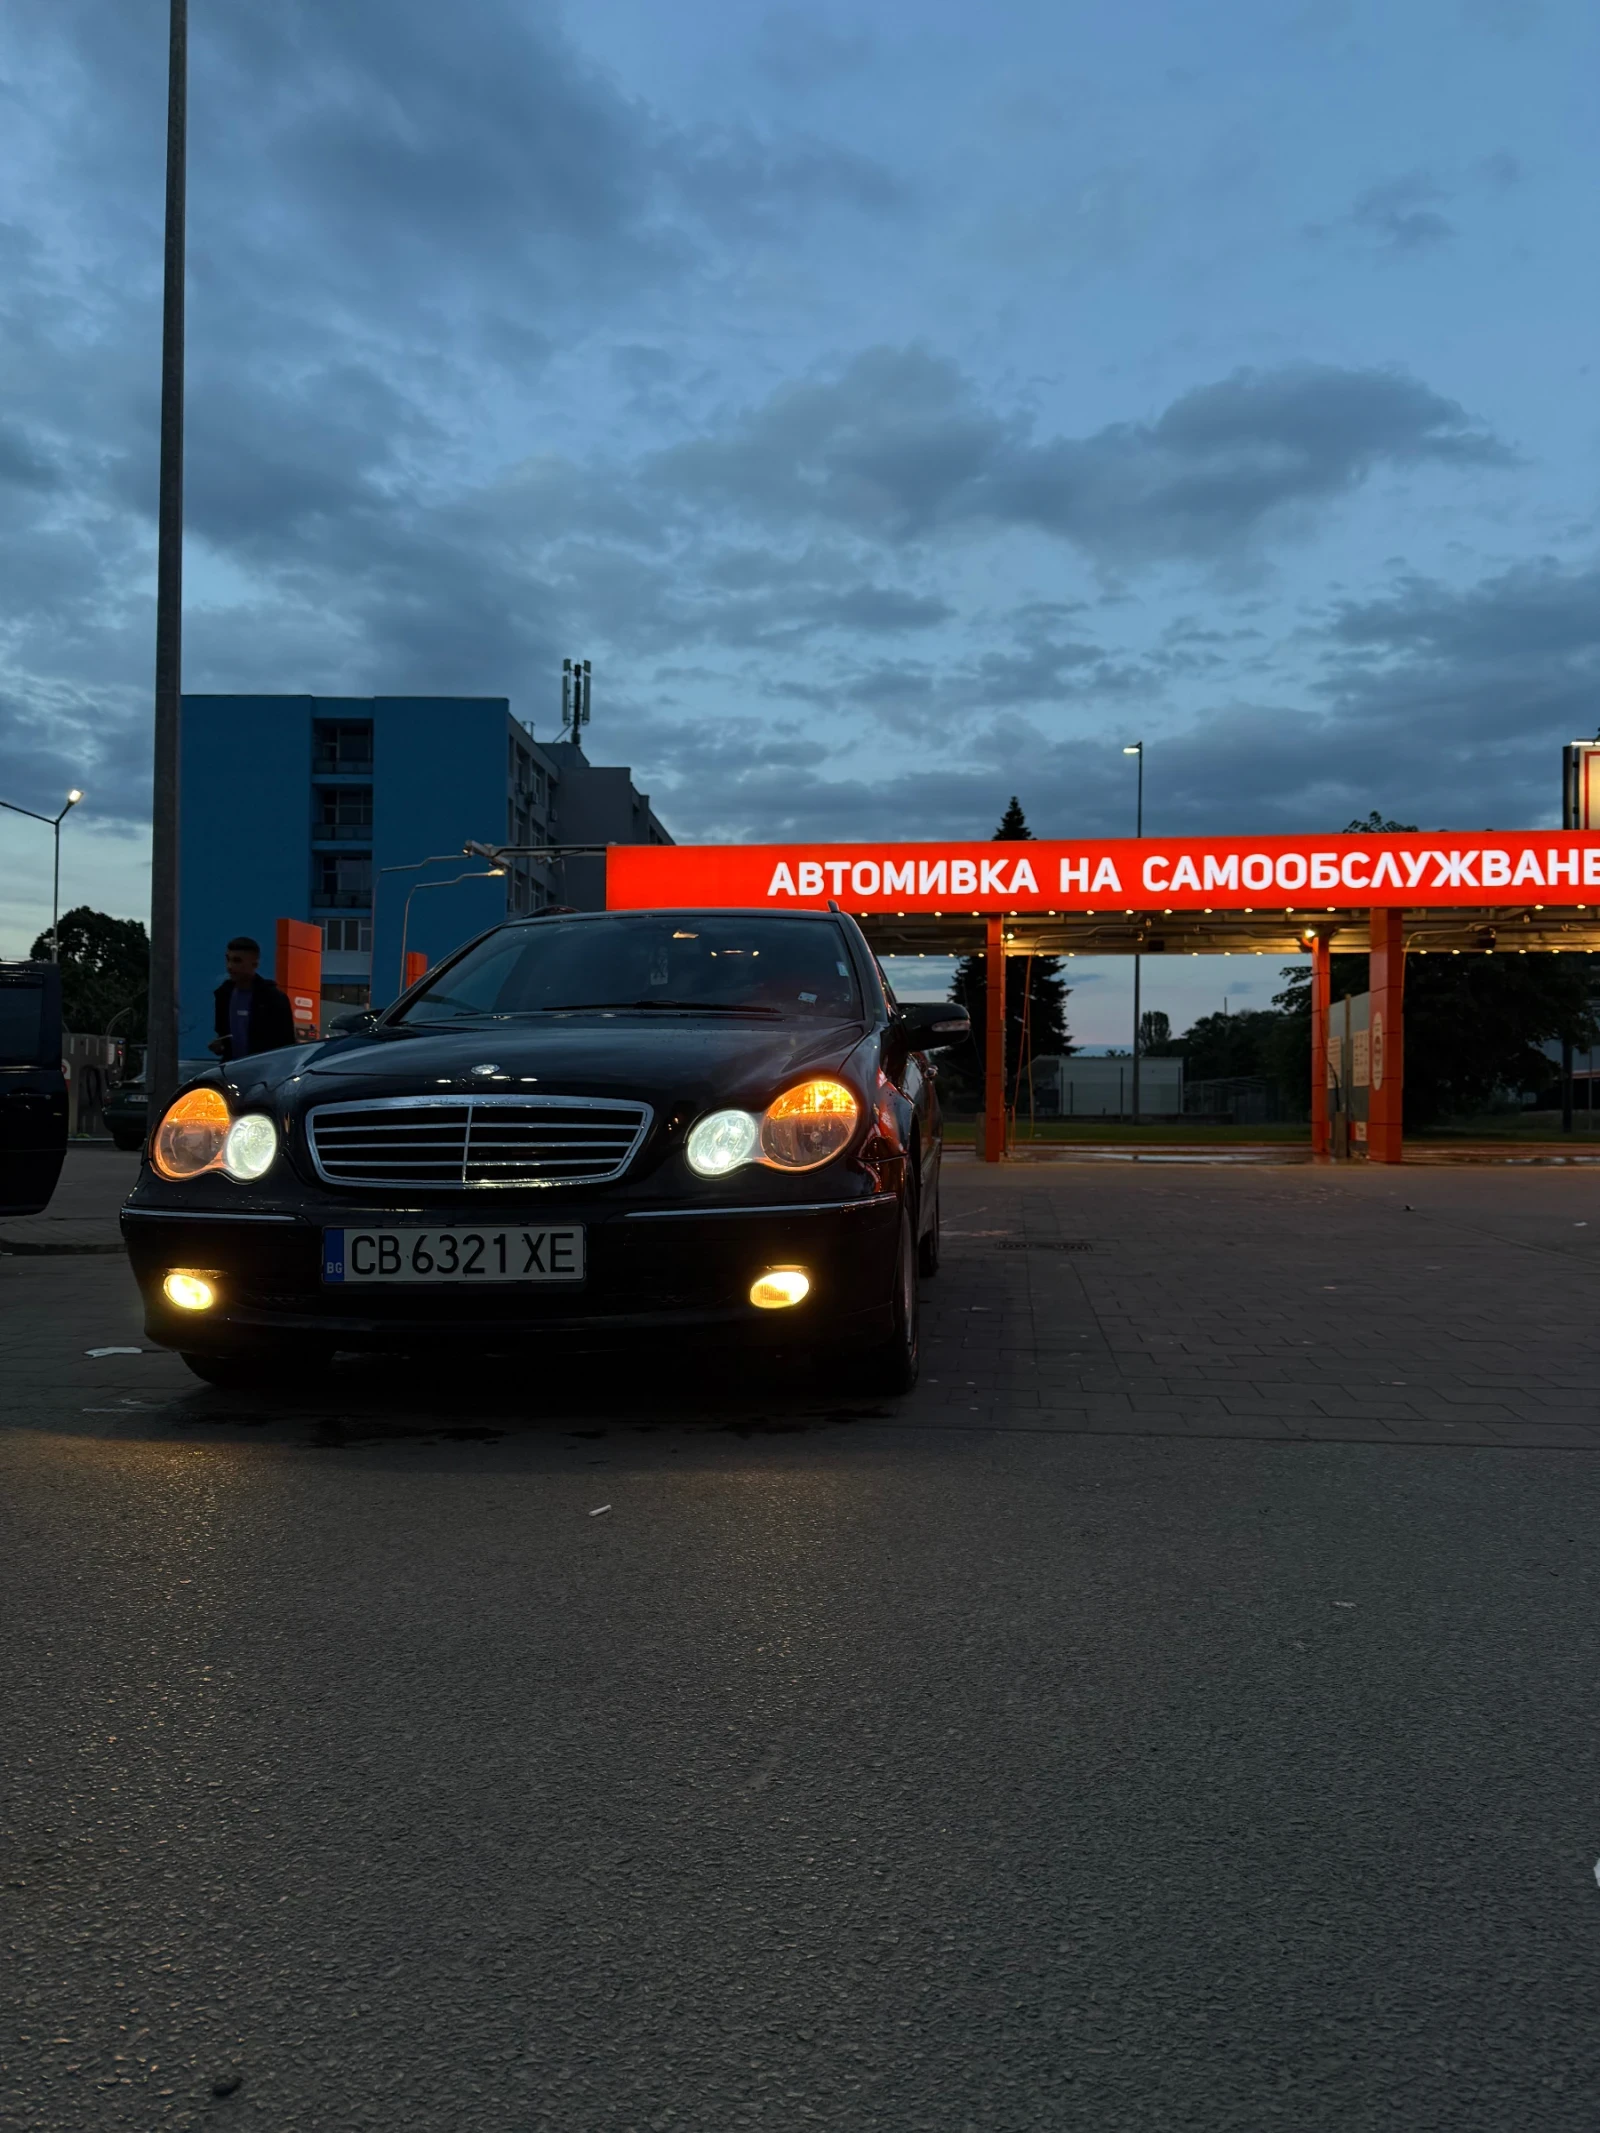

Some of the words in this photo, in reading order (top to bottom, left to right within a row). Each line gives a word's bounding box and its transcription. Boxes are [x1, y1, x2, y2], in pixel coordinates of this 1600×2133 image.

[767, 858, 1039, 896] АВТОМИВКА
[1060, 856, 1122, 893] НА
[1142, 847, 1600, 892] САМООБСЛУЖВАНЕ
[326, 1261, 343, 1275] BG
